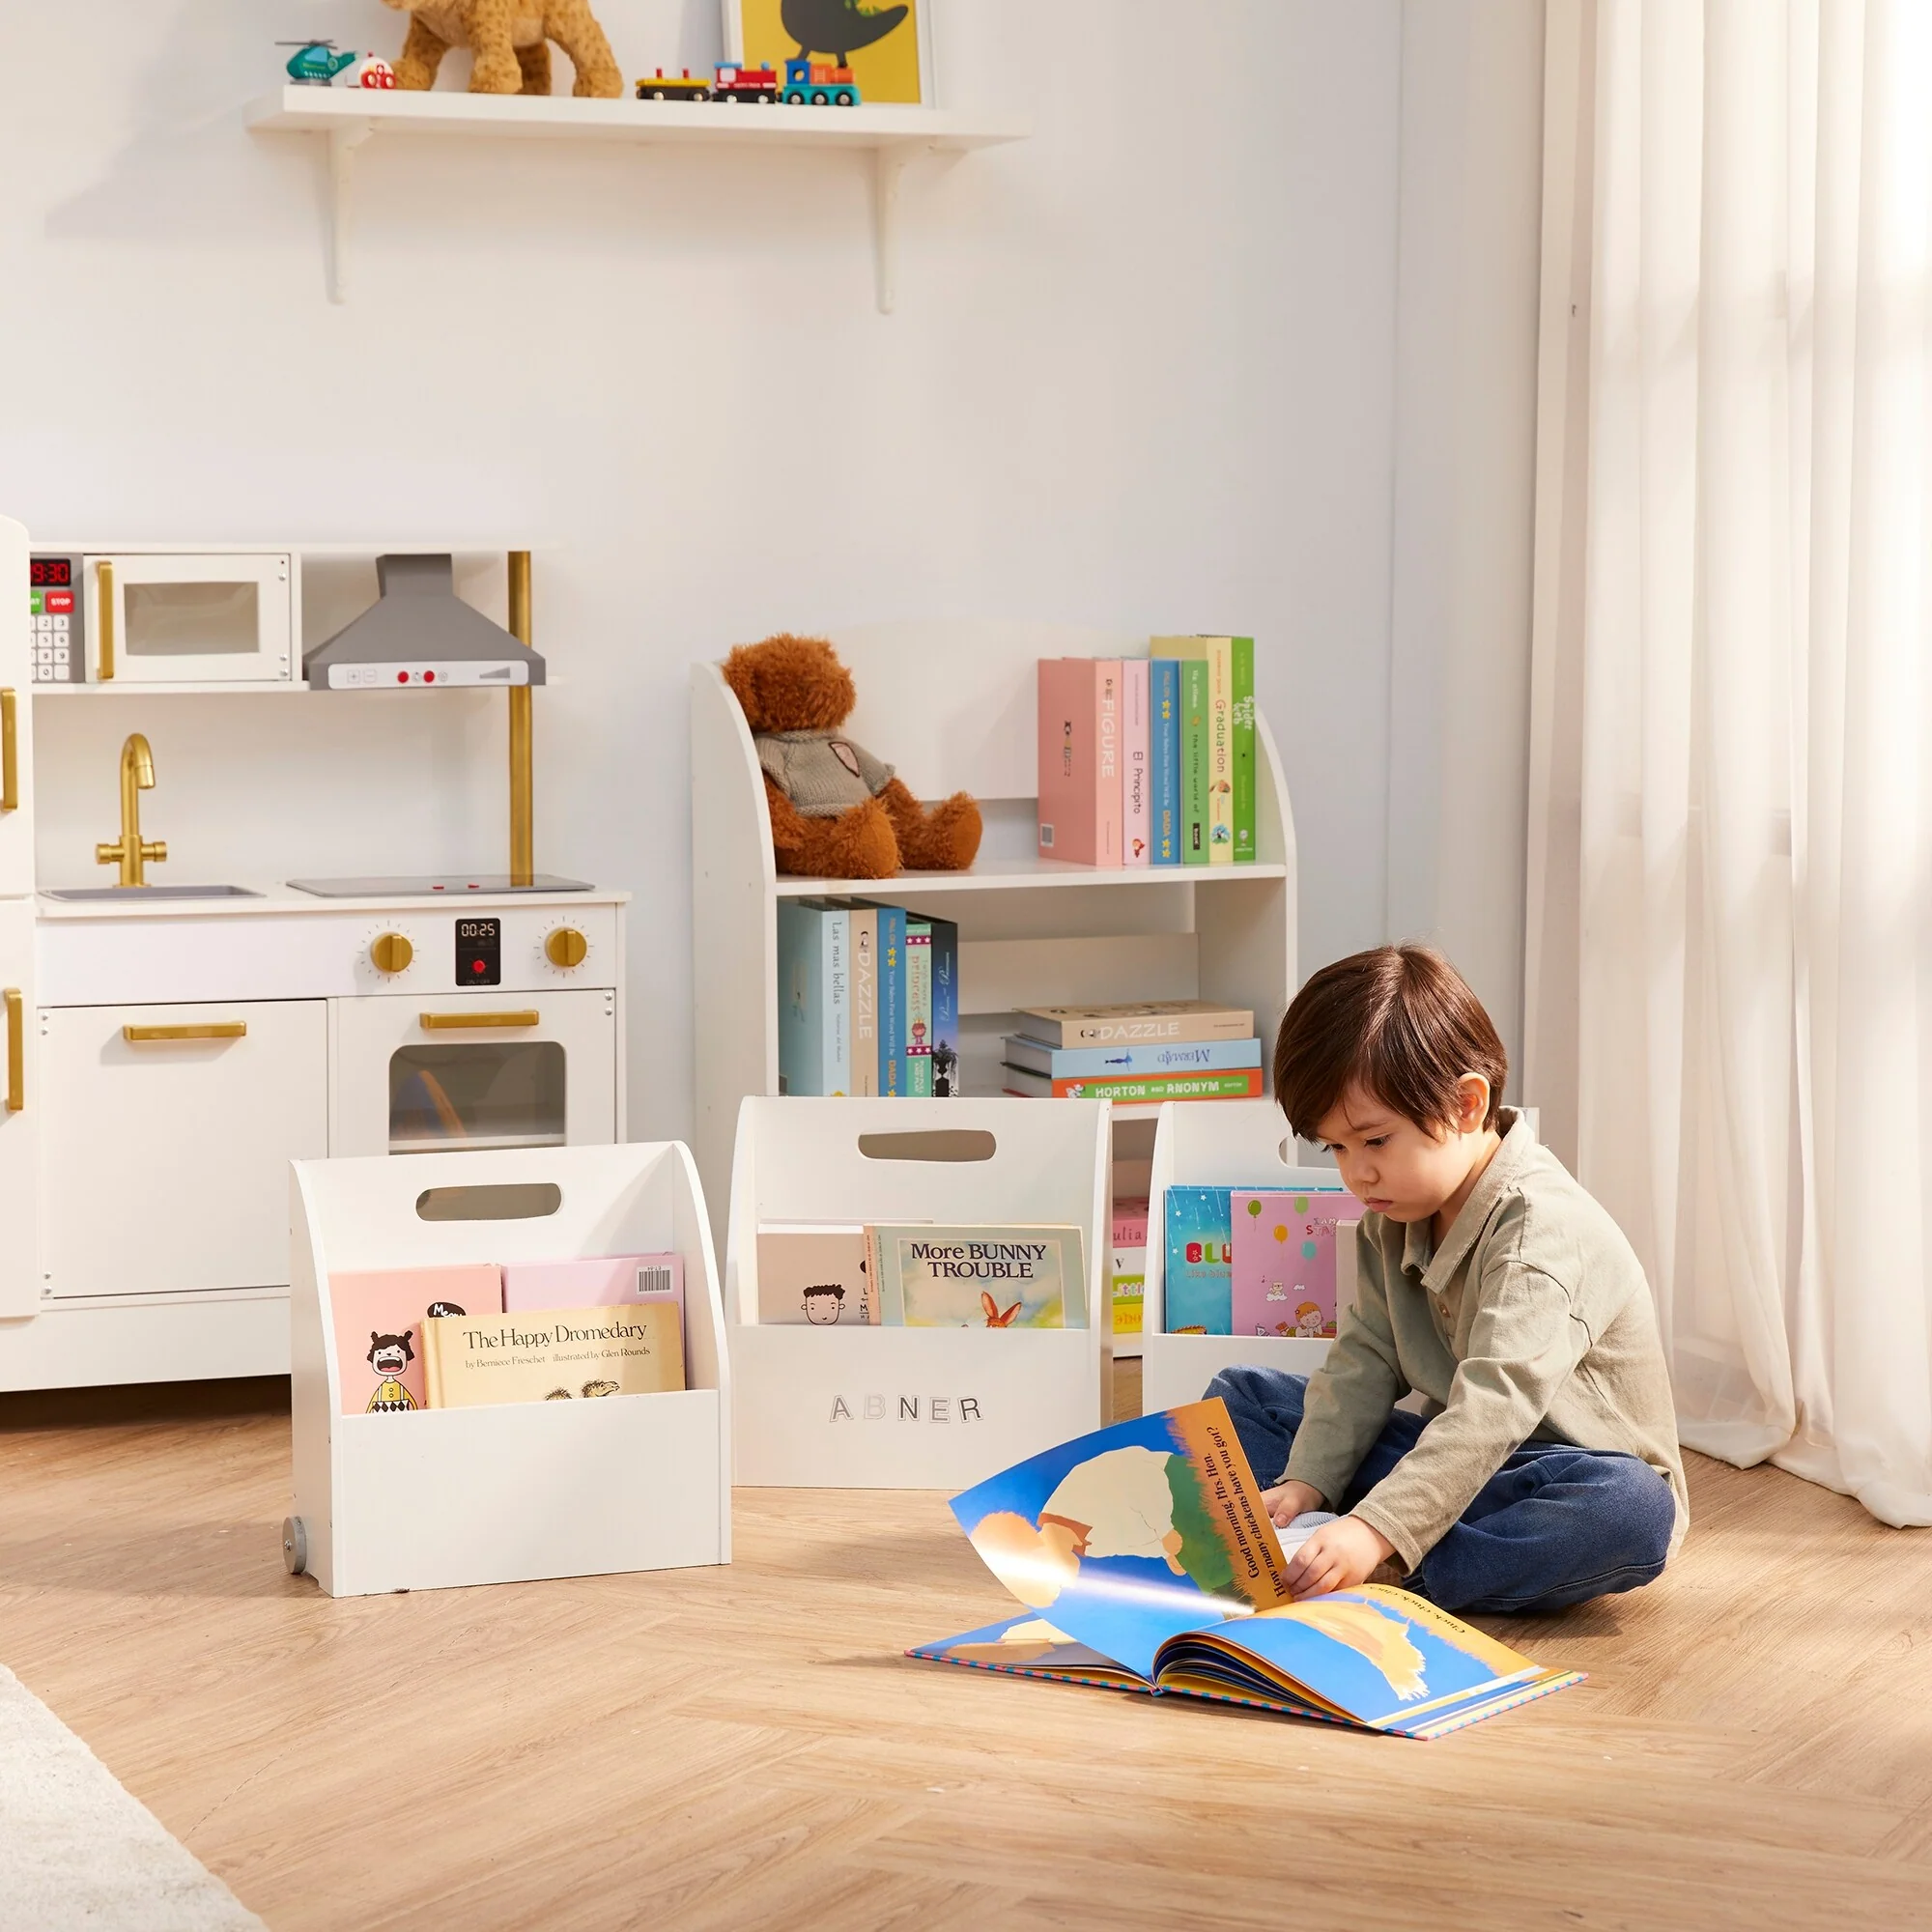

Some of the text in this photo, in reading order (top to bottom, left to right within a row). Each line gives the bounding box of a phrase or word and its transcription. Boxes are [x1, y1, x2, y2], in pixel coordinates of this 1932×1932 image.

[51, 597, 71, 606] STOP
[1241, 696, 1255, 730] Spider
[1101, 699, 1116, 778] FIGURE
[1215, 699, 1227, 773] Graduation
[1131, 768, 1144, 814] Principito
[461, 923, 495, 937] 00:25
[832, 922, 842, 941] Las
[833, 973, 844, 1006] bellas
[857, 952, 872, 1039] DAZZLE
[911, 955, 920, 1012] princess
[1099, 1022, 1180, 1040] DAZZLE
[888, 1060, 896, 1087] DADA
[1095, 1085, 1146, 1097] HORTON
[1112, 1227, 1142, 1241] ulia
[911, 1243, 1046, 1261] More BUNNY
[927, 1262, 1034, 1278] TROUBLE
[463, 1321, 647, 1349] The Happy Dromedary
[466, 1360, 476, 1369] by
[553, 1347, 650, 1362] illustrated by Glen Rounds
[829, 1394, 984, 1424] ABNER
[1204, 1453, 1260, 1578] Good morning, Mrs. Hen.
[1207, 1426, 1286, 1598] How many chickens have you got?
